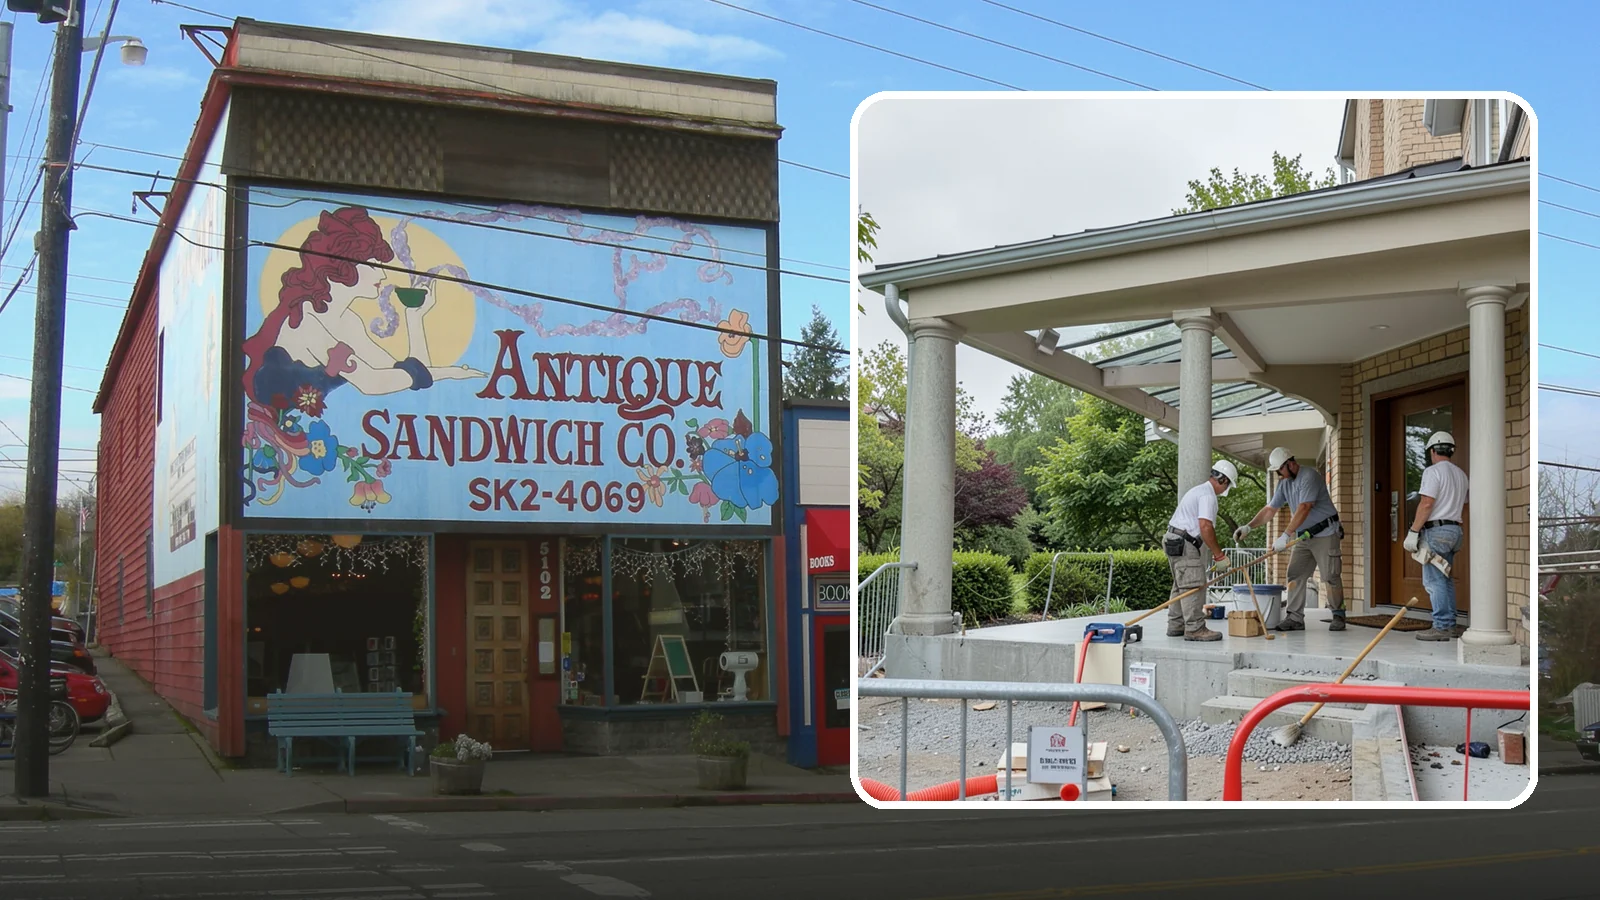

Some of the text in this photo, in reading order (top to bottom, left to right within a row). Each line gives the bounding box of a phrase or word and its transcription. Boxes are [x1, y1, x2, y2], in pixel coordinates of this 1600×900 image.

[476, 329, 723, 421] ANTIQUE
[361, 408, 685, 468] SANDWICH CO.
[468, 477, 646, 513] SK2-4069
[539, 541, 552, 600] 5102
[809, 555, 835, 569] BOOKS
